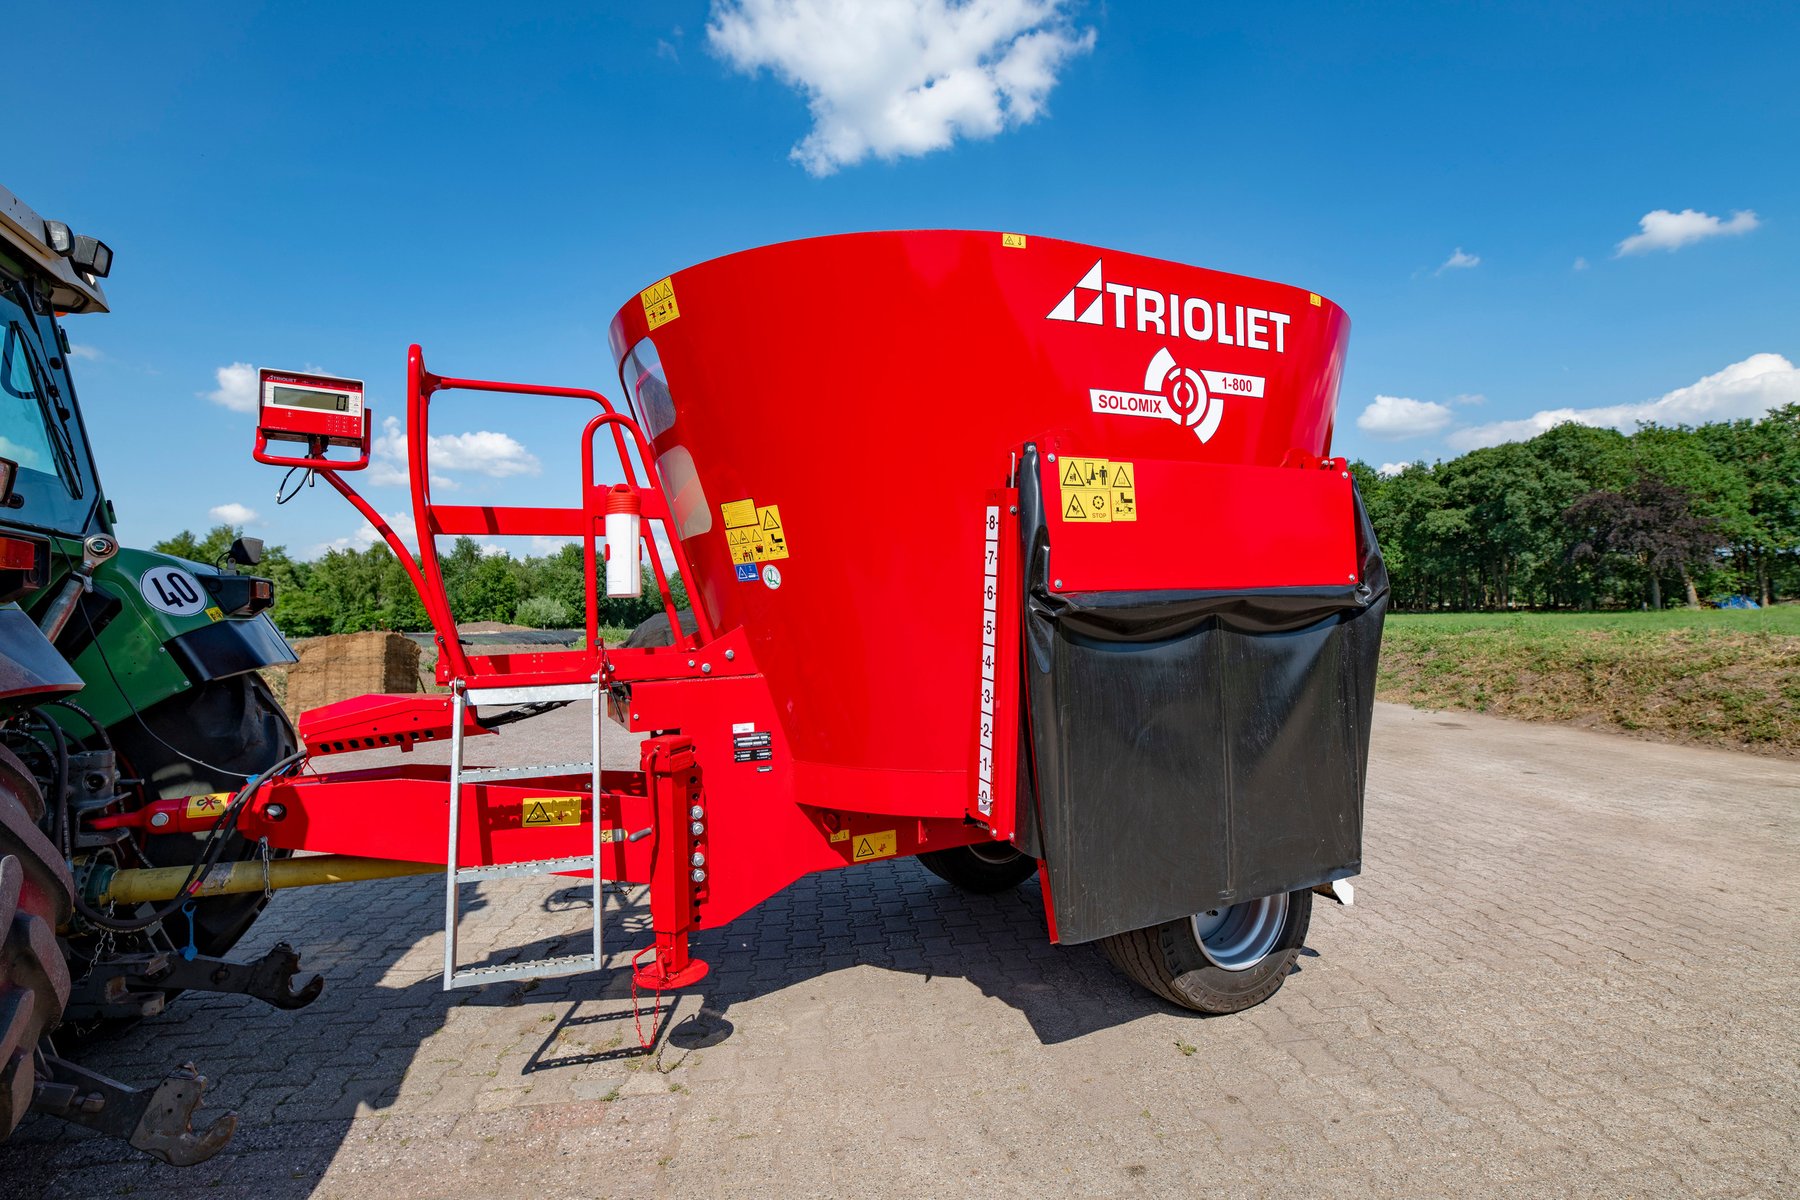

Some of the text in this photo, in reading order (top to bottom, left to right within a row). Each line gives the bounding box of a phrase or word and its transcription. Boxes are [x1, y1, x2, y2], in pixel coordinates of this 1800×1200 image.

[1106, 281, 1290, 353] TRIOLIET
[1221, 376, 1252, 392] 1-800
[1098, 394, 1162, 413] SOLOMIX
[988, 515, 996, 530] 8
[988, 551, 995, 565] 7
[151, 572, 199, 608] 40
[986, 585, 994, 600] 6
[985, 621, 992, 635] 5
[985, 655, 992, 669] 4
[984, 689, 991, 704] 3
[983, 723, 989, 738] 2
[982, 757, 988, 771] 1
